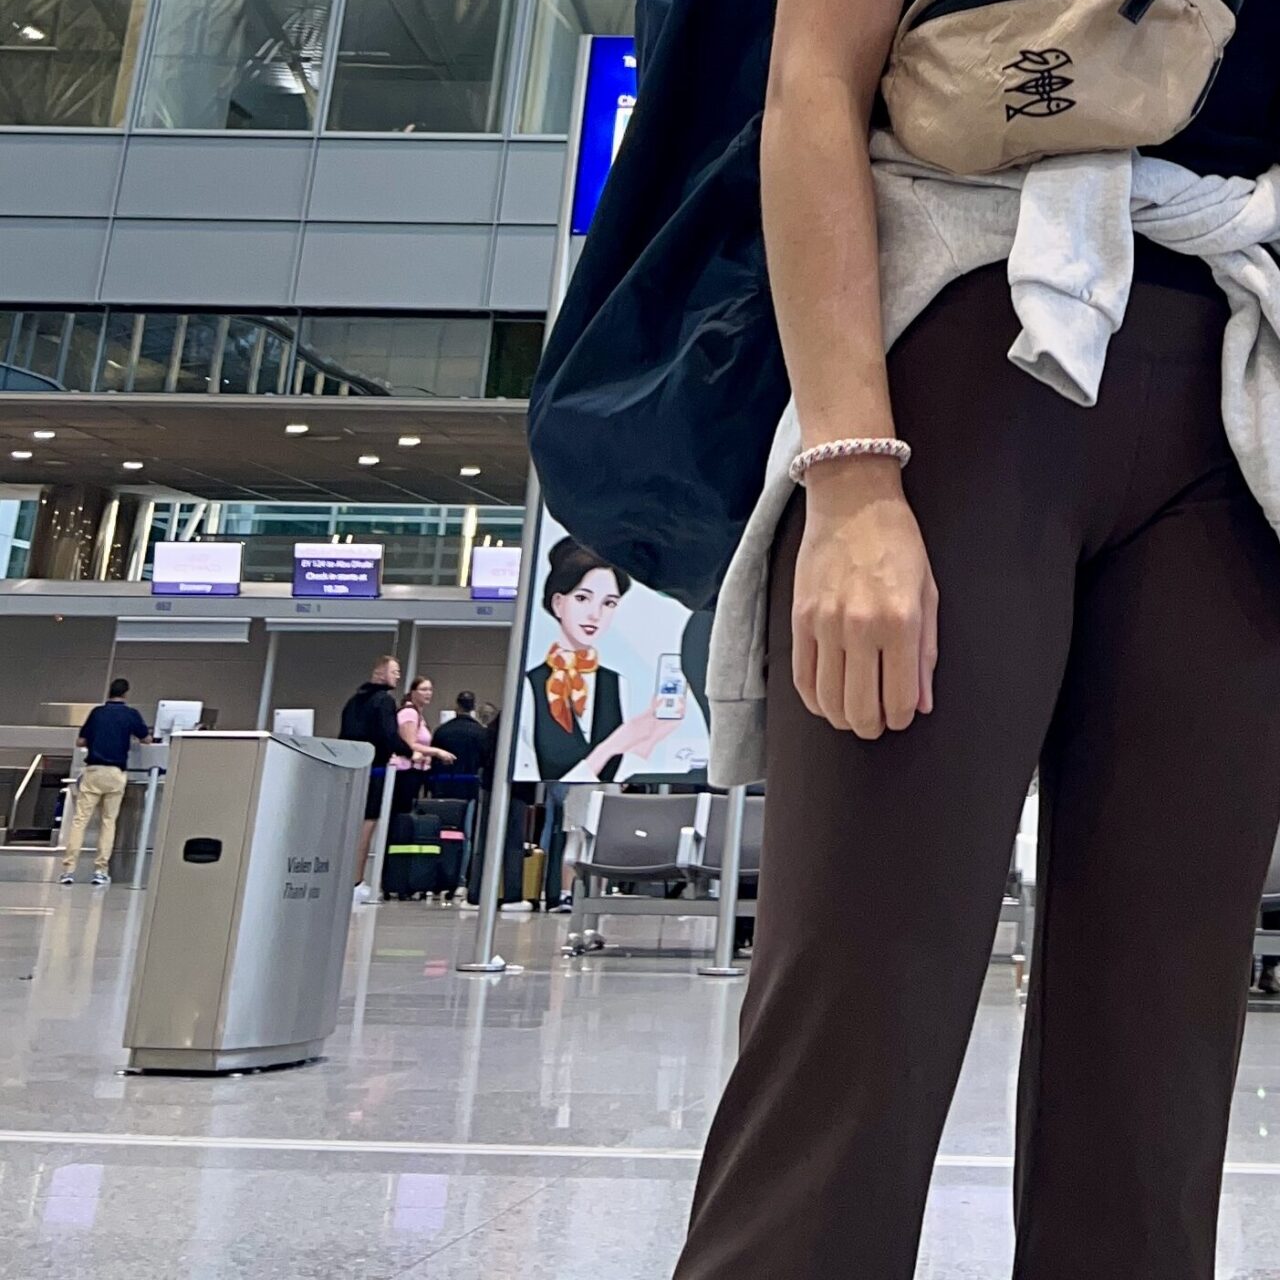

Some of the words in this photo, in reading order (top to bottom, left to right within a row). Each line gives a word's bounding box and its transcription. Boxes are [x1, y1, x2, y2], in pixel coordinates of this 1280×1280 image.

[287, 856, 312, 873] Vielen
[283, 882, 307, 899] Thank
[307, 887, 321, 901] you
